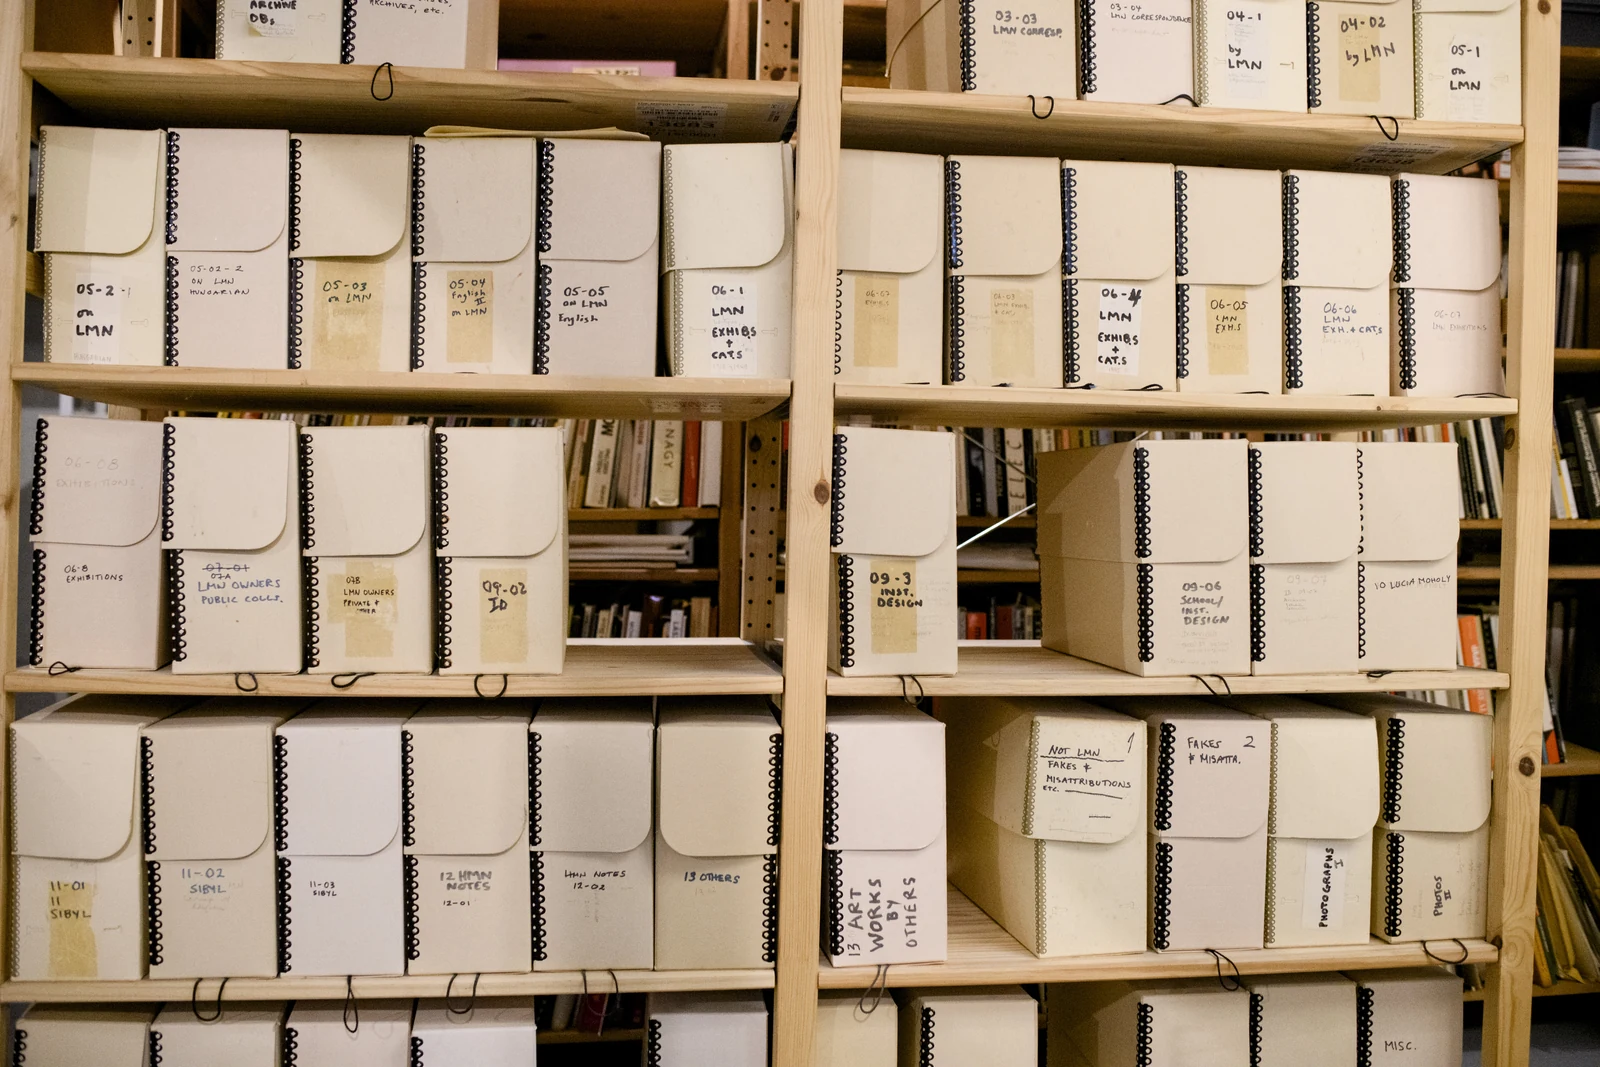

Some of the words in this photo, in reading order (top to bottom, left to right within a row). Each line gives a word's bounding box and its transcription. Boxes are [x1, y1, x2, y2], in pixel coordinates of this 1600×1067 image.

[423, 7, 445, 15] etc.
[1110, 3, 1142, 12] 03-04
[995, 11, 1037, 24] 03-03
[993, 25, 1017, 35] LMN
[1340, 17, 1387, 33] 04-02
[1228, 45, 1242, 58] by
[1346, 51, 1360, 66] by
[1364, 43, 1396, 62] LMN
[1451, 44, 1481, 58] 05-1
[1228, 59, 1263, 70] LMN
[1451, 66, 1467, 76] on
[1450, 80, 1481, 91] LMN
[322, 280, 367, 292] 05-03
[564, 286, 610, 297] 05-05
[346, 293, 372, 304] LMN
[582, 299, 608, 308] LMN
[1210, 299, 1249, 310] 06-05
[1323, 302, 1357, 314] 06-06
[76, 308, 94, 318] on
[465, 308, 487, 316] LMN
[711, 306, 745, 317] LMN
[1099, 311, 1132, 322] LMN
[558, 313, 598, 326] English
[76, 325, 114, 337] LMN
[663, 428, 675, 469] NAGY
[64, 564, 88, 573] 06-8
[66, 574, 124, 583] EXHIBITIONS
[869, 571, 912, 585] 09-3
[1389, 578, 1415, 589] LUCIA
[1418, 575, 1451, 585] MOHOLY
[197, 581, 226, 592] LMN
[231, 579, 281, 590] OWNERS
[1182, 581, 1222, 592] 09-06
[880, 588, 914, 597] INST.
[201, 595, 238, 605] PUBLIC
[877, 597, 923, 608] DESIGN
[1183, 616, 1230, 626] DESIGN
[1187, 736, 1222, 749] FAKES
[1243, 735, 1256, 749] 2
[1048, 744, 1069, 755] NOT
[1077, 748, 1100, 757] LMN
[1047, 760, 1077, 770] FAKES
[1046, 774, 1131, 789] MISATTRIBUTIONS
[181, 868, 225, 879] 11-02
[440, 871, 455, 882] 12
[458, 870, 492, 881] HMN
[594, 869, 626, 878] NOTES
[699, 872, 741, 884] OTHERS
[50, 881, 85, 891] 11-01
[190, 885, 226, 895] SIBYL
[309, 881, 335, 889] 11-03
[446, 881, 491, 891] NOTES
[573, 882, 606, 890] 12-02
[1318, 847, 1334, 928] PHOTOGRAPHS
[1433, 875, 1443, 917] PHOTOS
[50, 909, 91, 919] SIBYL
[847, 888, 864, 930] ART
[886, 900, 902, 921] BY
[903, 877, 918, 947] OTHERS
[867, 879, 884, 952] WORKS
[1384, 1040, 1417, 1052] MISC.
